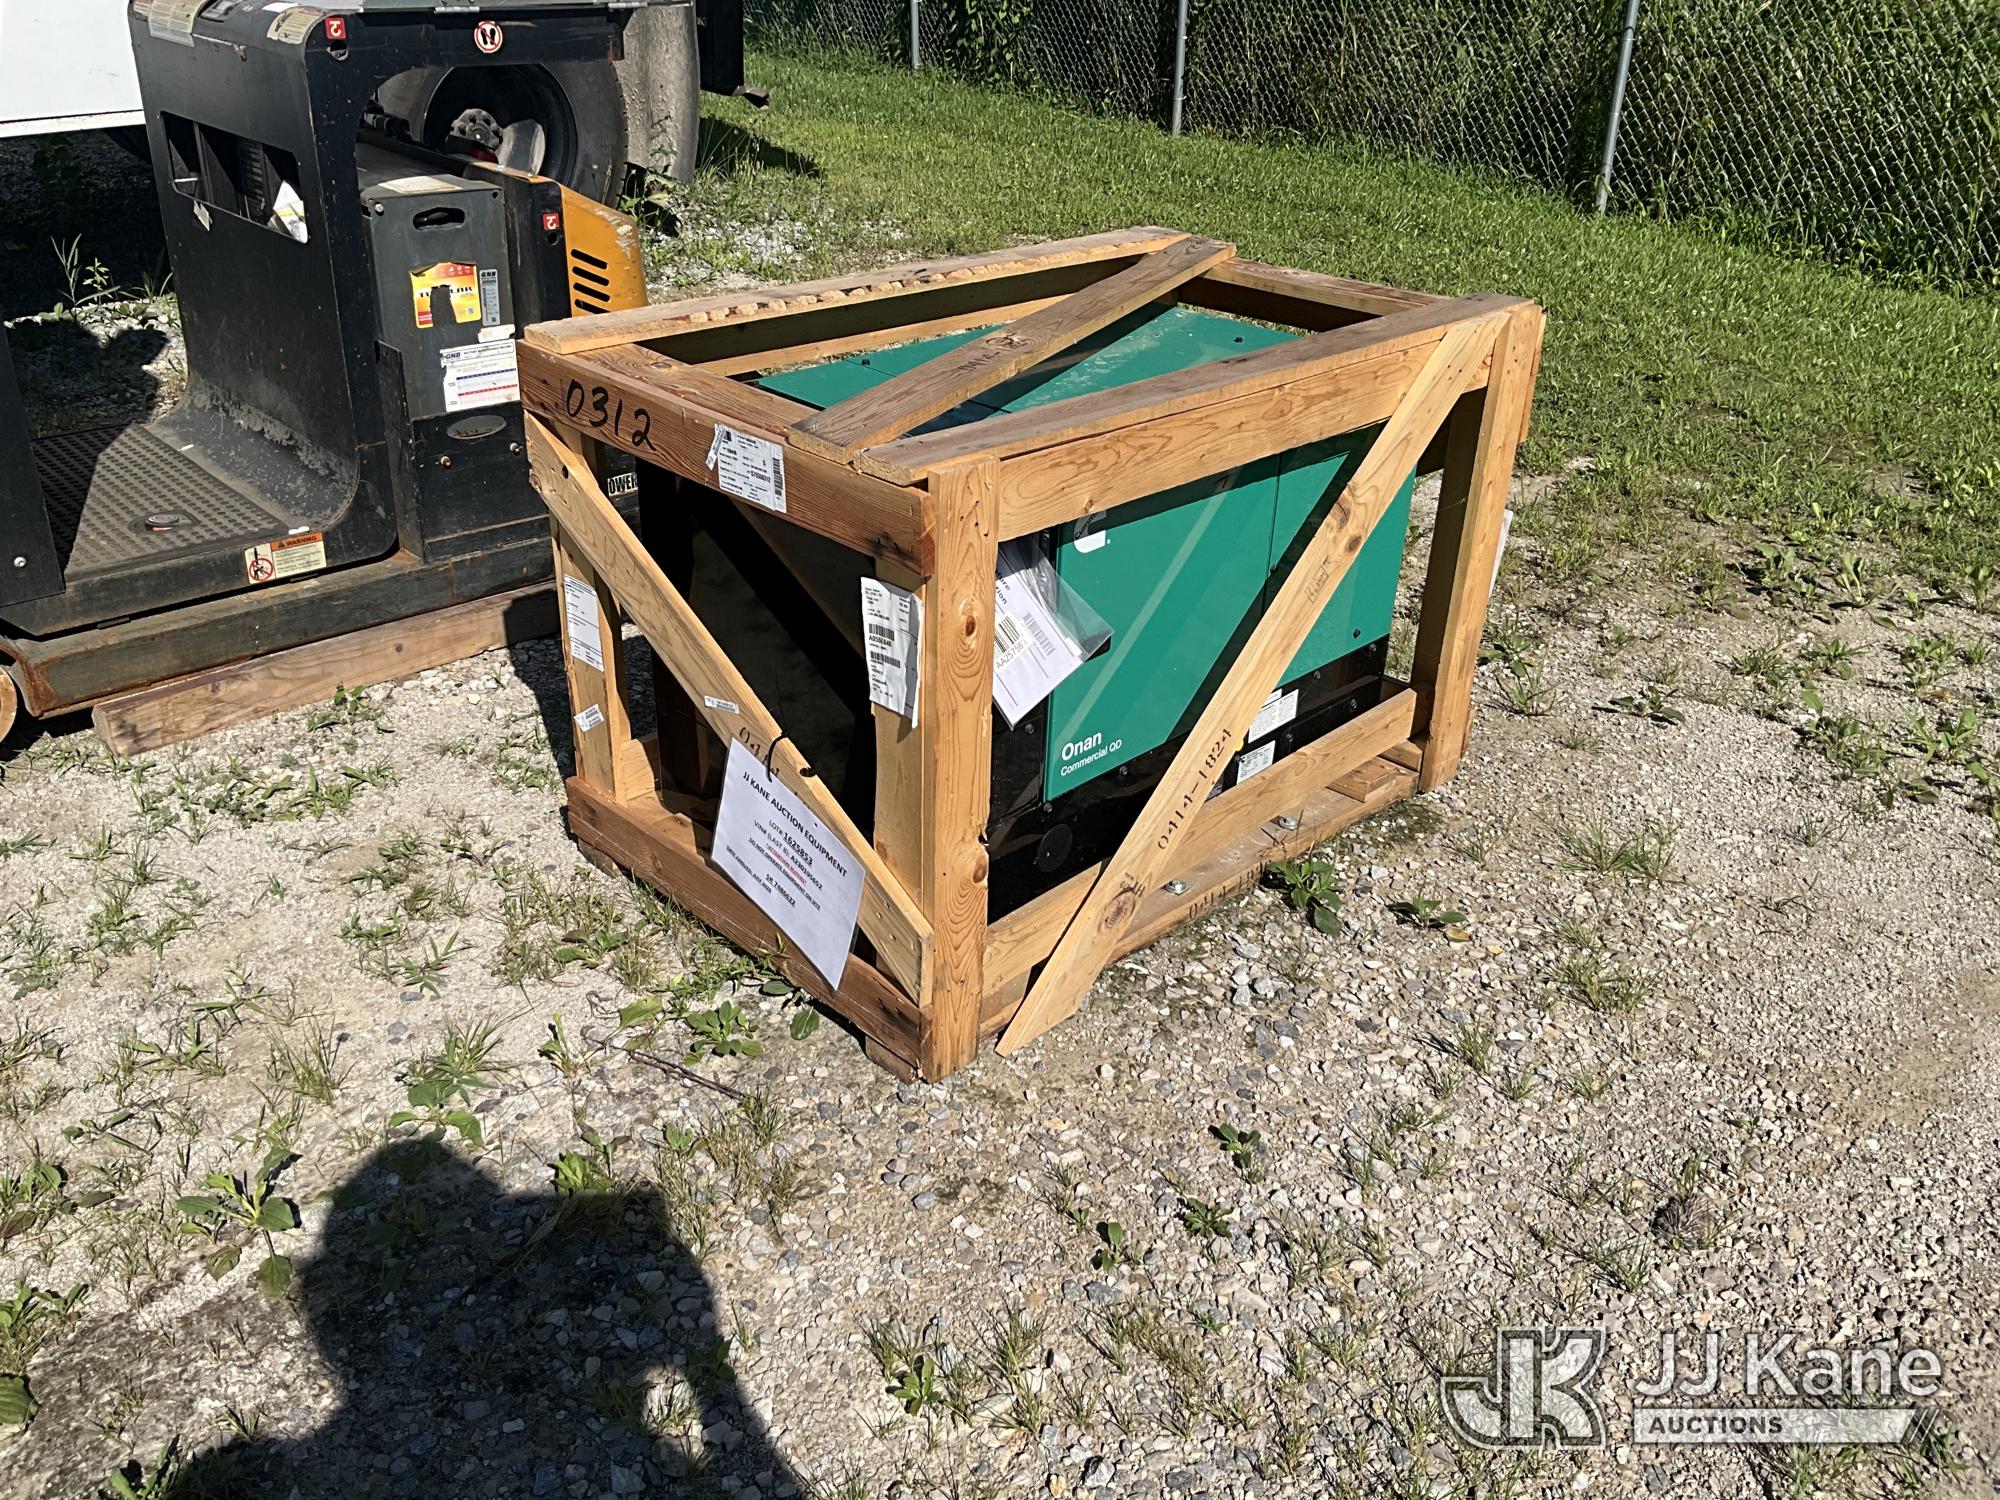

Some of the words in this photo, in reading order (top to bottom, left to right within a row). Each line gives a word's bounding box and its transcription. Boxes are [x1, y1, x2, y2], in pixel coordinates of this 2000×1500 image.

[566, 379, 656, 451] 0312
[609, 473, 639, 496] OWER
[286, 535, 317, 547] WARNING
[1060, 745, 1108, 777] Commercial
[1109, 739, 1122, 752] QD
[1061, 732, 1102, 761] Onan
[742, 772, 750, 781] JJ
[750, 778, 771, 801] KANE
[770, 798, 804, 833] AUCTION
[804, 829, 848, 878] EQUIPMENT
[783, 832, 814, 867] 1625853
